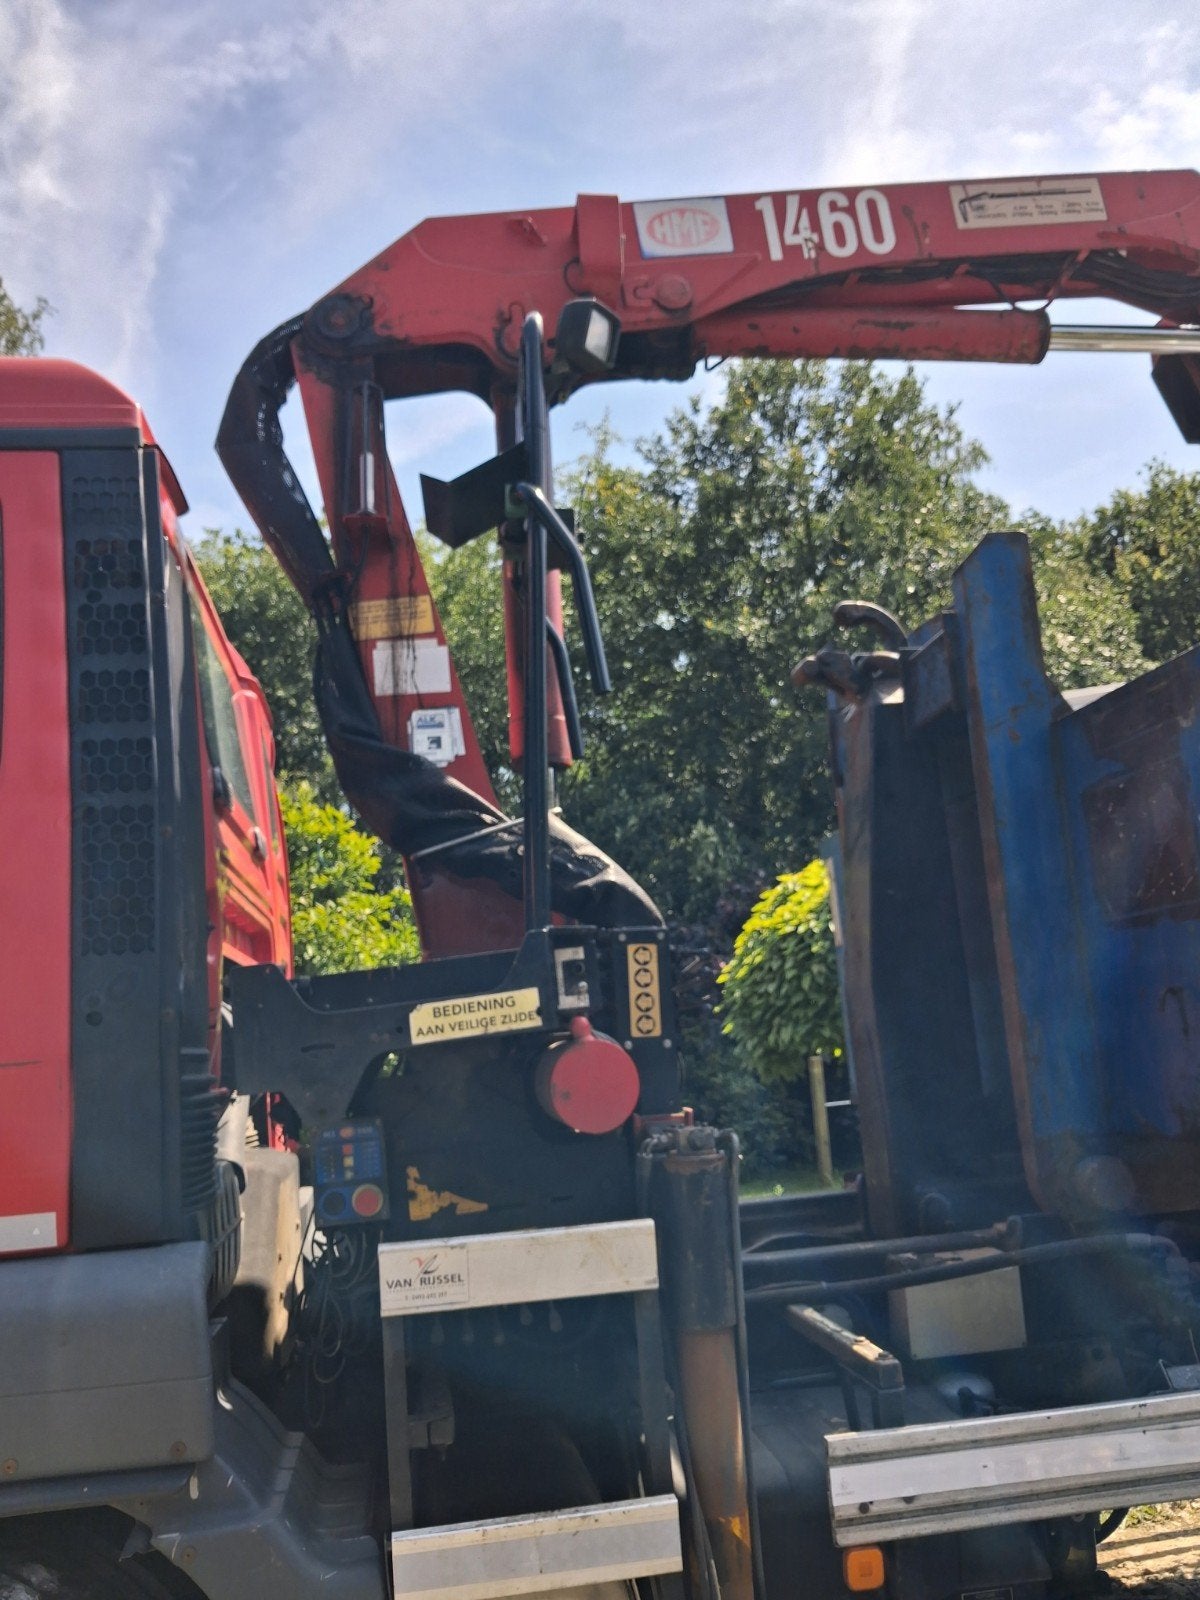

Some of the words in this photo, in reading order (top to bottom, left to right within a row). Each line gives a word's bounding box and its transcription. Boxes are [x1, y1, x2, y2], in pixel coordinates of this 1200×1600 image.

[754, 189, 897, 262] 1460
[432, 995, 516, 1018] BEDIENING
[416, 1023, 445, 1037] AAN
[449, 1016, 497, 1032] VEILIGE
[501, 1010, 536, 1025] ZIJDE
[386, 1278, 412, 1290] VAN
[420, 1273, 464, 1287] RIJSSEL
